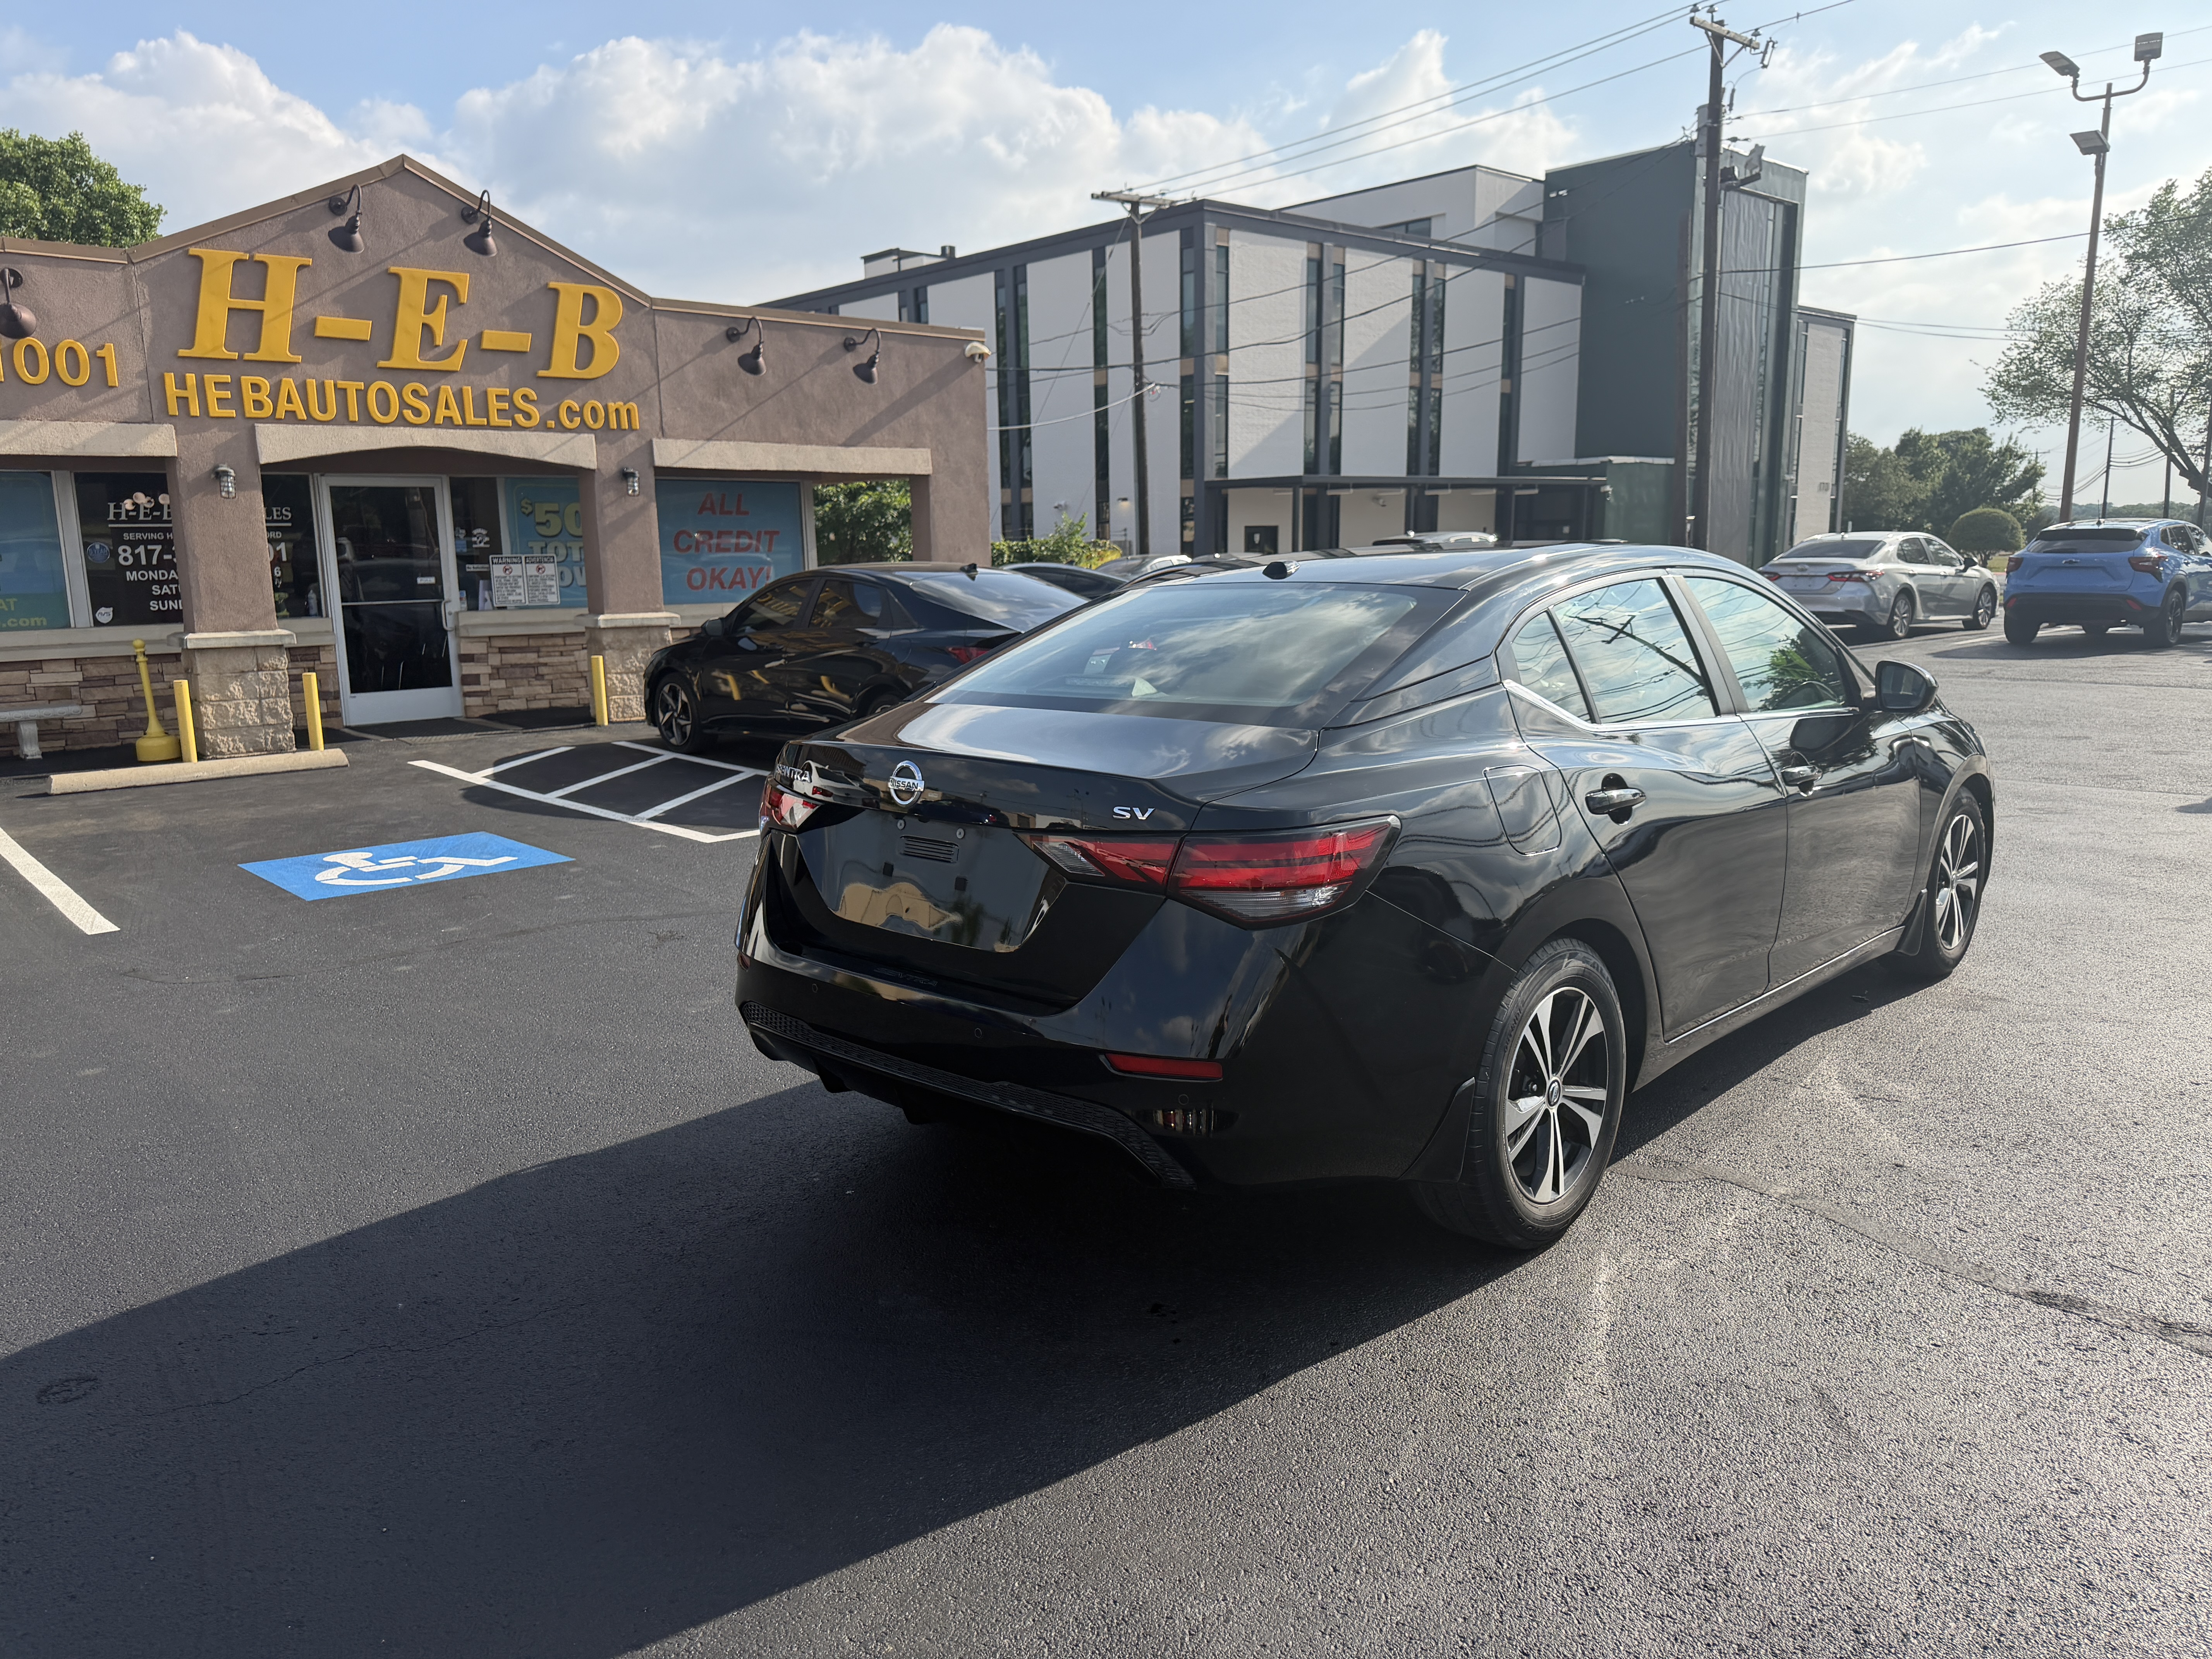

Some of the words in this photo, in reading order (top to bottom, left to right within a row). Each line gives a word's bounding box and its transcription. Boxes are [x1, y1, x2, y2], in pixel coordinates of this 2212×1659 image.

[177, 248, 624, 380] H-E-B
[0, 336, 118, 387] 001
[163, 372, 640, 431] HEBAUTOSALES.com
[265, 507, 292, 520] LES
[698, 492, 750, 516] ALL
[520, 498, 583, 538] $50
[527, 540, 584, 562] TOT
[673, 529, 781, 554] CREDIT
[118, 544, 177, 566] 817-
[126, 569, 179, 581] MONDA
[274, 567, 282, 577] 6
[686, 567, 772, 591] OKAY!
[152, 584, 180, 595] SAT
[0, 616, 47, 627] .com
[776, 763, 812, 783] SENTRA
[890, 778, 919, 789] NISSAN
[1112, 806, 1155, 820] SV
